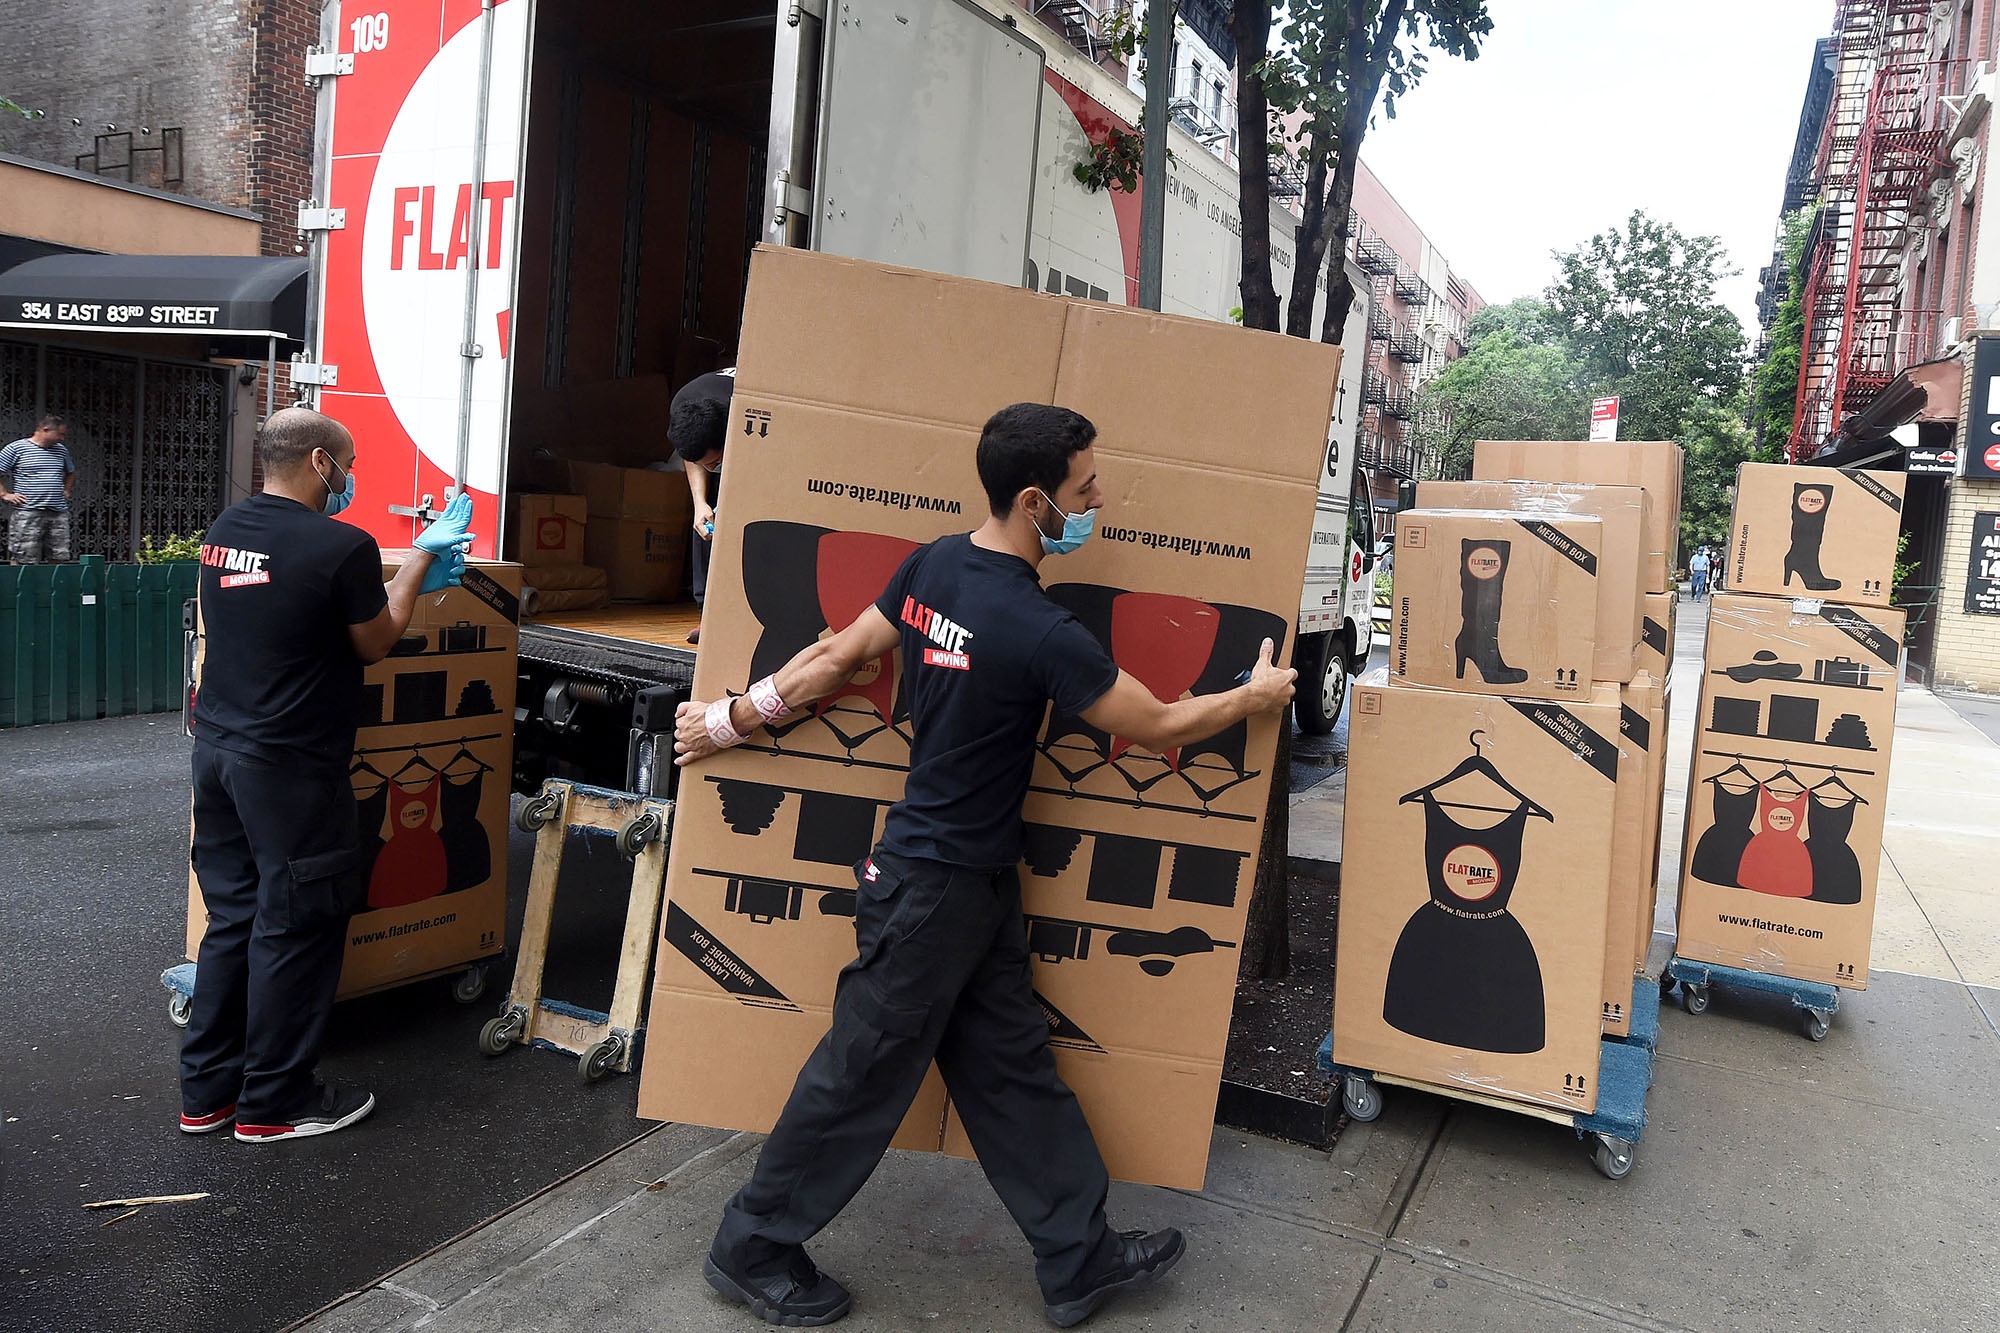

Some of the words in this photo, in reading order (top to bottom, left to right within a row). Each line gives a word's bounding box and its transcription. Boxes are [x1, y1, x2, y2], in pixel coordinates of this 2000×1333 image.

[350, 12, 390, 54] 109
[1182, 182, 1200, 210] YORK
[390, 180, 515, 270] FLAT
[1206, 200, 1220, 223] LOS
[1220, 209, 1243, 238] ANGELE
[1270, 243, 1291, 270] ANCISCO
[21, 302, 52, 320] 354
[57, 303, 102, 322] EAST
[106, 305, 144, 323] 83RD
[150, 305, 220, 324] STREET
[808, 478, 962, 514] www.flatrate.com
[1854, 473, 1881, 495] MEDIUM
[1879, 490, 1895, 504] BOX
[1101, 525, 1251, 560] www.flatrate.com
[1312, 531, 1341, 546] INTERNATIONAL
[1536, 524, 1570, 552] MEDIUM
[1568, 544, 1589, 564] BOX
[1736, 524, 1749, 584] www.flatrate.com
[230, 572, 268, 585] MOVING
[478, 577, 499, 595] LARGE
[1397, 596, 1410, 677] www.flatrate.com
[1642, 628, 1651, 638] OX
[1832, 612, 1868, 641] WROBE
[1865, 637, 1881, 651] BOX
[932, 651, 968, 668] MOVING
[1533, 708, 1578, 746] WARDROBE
[1576, 740, 1596, 758] BOX
[1556, 713, 1584, 738] SMALL
[1620, 720, 1631, 731] OX
[1434, 898, 1506, 920] www.flatrate.com
[351, 911, 457, 946] www.flatrate.com
[690, 930, 710, 950] BOX
[1718, 913, 1824, 940] www.flatrate.com
[700, 953, 732, 981] LARGE
[707, 944, 756, 988] WARDROBE
